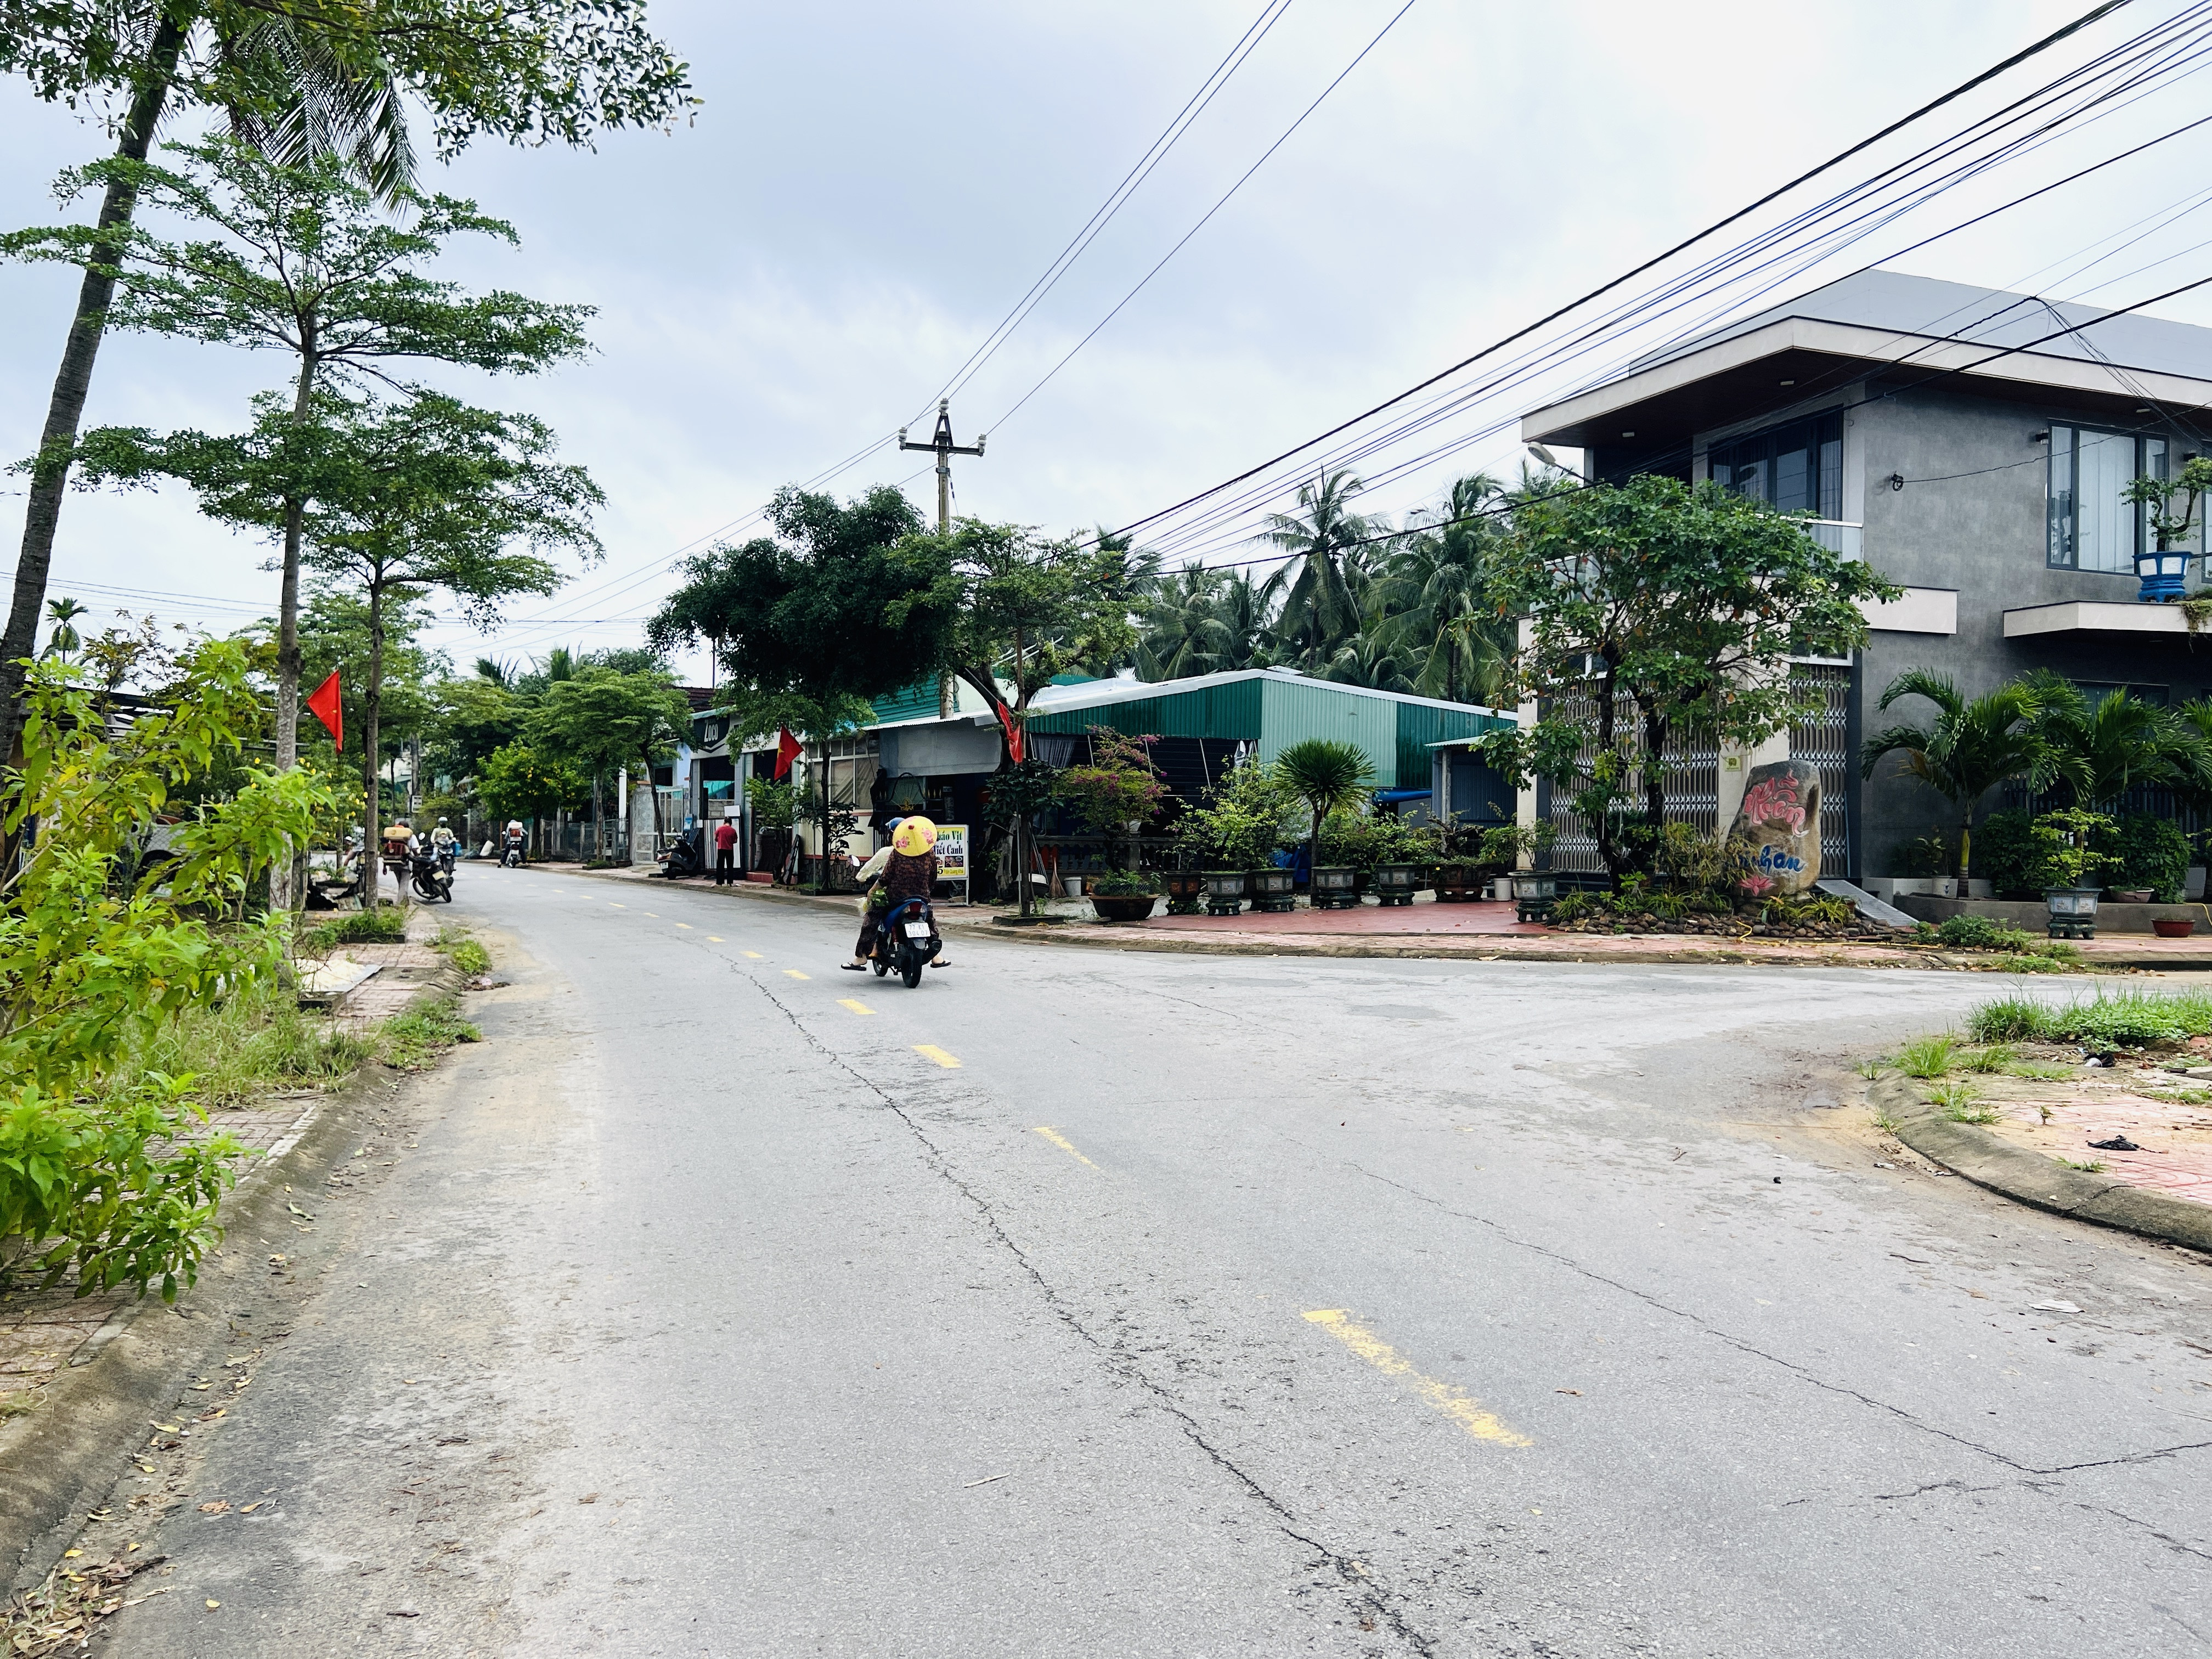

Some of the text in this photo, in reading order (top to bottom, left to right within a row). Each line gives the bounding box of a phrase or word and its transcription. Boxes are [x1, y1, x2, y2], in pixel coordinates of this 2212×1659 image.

[938, 830, 962, 844] háo Vịt
[934, 842, 963, 855] Tiết Canh
[1774, 853, 1806, 872] an
